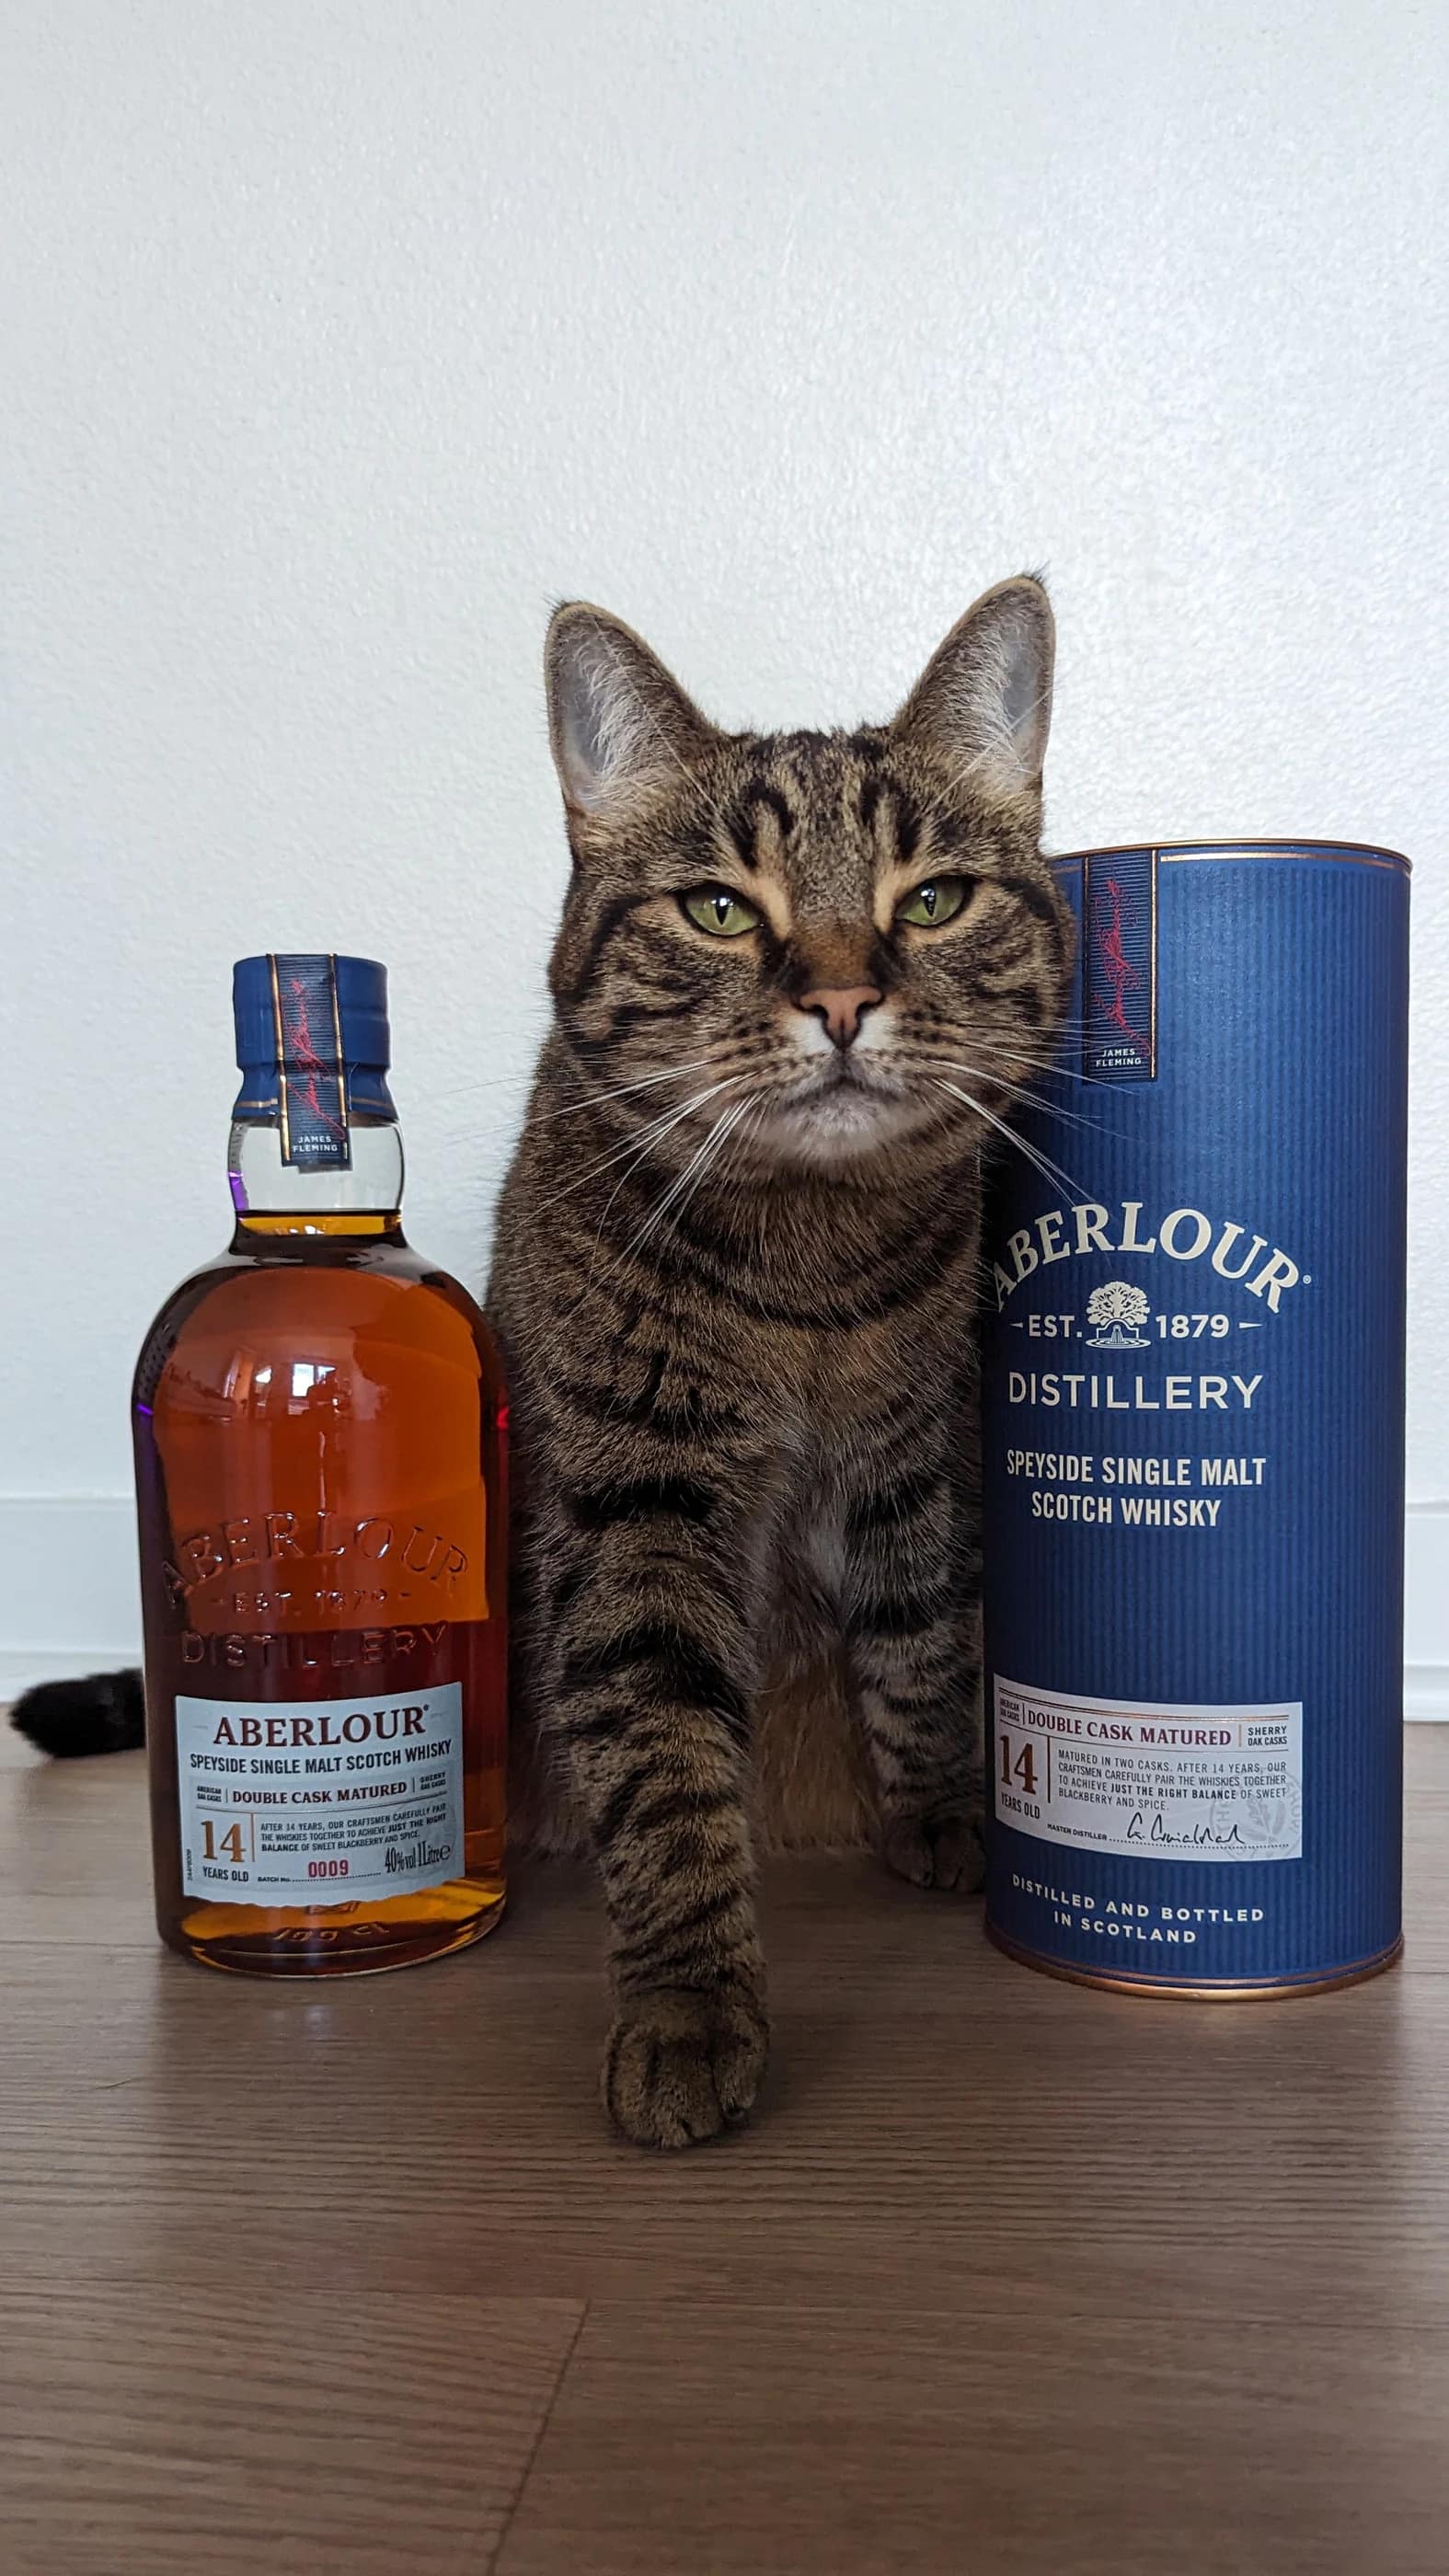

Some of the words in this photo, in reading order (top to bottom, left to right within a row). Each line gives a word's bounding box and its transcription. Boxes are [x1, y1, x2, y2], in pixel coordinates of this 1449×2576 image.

[1096, 1056, 1143, 1067] FLEMING
[1102, 1047, 1136, 1058] JAMES
[293, 1144, 339, 1153] FLEMING
[297, 1135, 332, 1144] JAMES
[1029, 1315, 1083, 1338] EST.
[1156, 1315, 1230, 1339] 1879
[1008, 1372, 1264, 1409] DISTILLERY
[1006, 1449, 1094, 1483] SPEYSIDE
[1102, 1457, 1191, 1487] SINGLE
[1201, 1457, 1267, 1487] MALT
[1031, 1491, 1112, 1524] SCOTCH
[1120, 1497, 1222, 1527] WHISKY
[162, 1512, 467, 1609] ABERLOUR
[182, 1620, 449, 1668] DISTILLERY
[1028, 1709, 1082, 1735] DOUBLE
[1087, 1721, 1133, 1742] CASK
[1140, 1727, 1232, 1746] MATURED
[1248, 1725, 1288, 1736] SHERRY
[1248, 1737, 1262, 1746] OAK
[1264, 1736, 1288, 1746] CASKS
[190, 1754, 247, 1774] SPEYSIDE
[250, 1758, 301, 1774] SINGLE
[305, 1757, 343, 1774] MALT
[346, 1749, 401, 1771] SCOTCH
[405, 1739, 453, 1763] WHISKY
[1000, 1734, 1039, 1795] 14
[1058, 1749, 1098, 1765] MATURED
[1101, 1755, 1110, 1766] IN
[1115, 1757, 1133, 1769] TWO
[1137, 1760, 1173, 1772] CASKS.
[1177, 1763, 1208, 1774] AFTER
[1213, 1764, 1224, 1774] 14
[1228, 1763, 1264, 1775] YEARS,
[1267, 1761, 1286, 1772] OUR
[1058, 1763, 1102, 1778] CRAFTSMEN
[1104, 1769, 1152, 1784] CAREFULLY
[1155, 1775, 1175, 1785] PAIR
[1179, 1776, 1195, 1786] THE
[1199, 1776, 1240, 1787] WHISKIES
[1244, 1775, 1287, 1786] TOGETHER
[1058, 1775, 1068, 1786] TO
[1071, 1777, 1108, 1792] ACHIEVE
[1110, 1783, 1133, 1795] JUST
[1136, 1786, 1154, 1797] THE
[1157, 1788, 1189, 1799] RIGHT
[1191, 1789, 1237, 1800] BALANCE
[1241, 1789, 1253, 1799] OF
[1256, 1788, 1287, 1799] SWEET
[233, 1790, 288, 1803] DOUBLE
[292, 1790, 332, 1803] CASK
[338, 1781, 408, 1801] MATURED
[1058, 1788, 1112, 1805] BLACKBERRY
[1115, 1797, 1134, 1808] AND
[1137, 1800, 1169, 1811] SPICE.
[1001, 1791, 1022, 1813] YEARS
[1024, 1800, 1041, 1820] OLD
[260, 1823, 282, 1832] AFTER
[286, 1823, 295, 1831] 14
[298, 1822, 326, 1832] YEARS,
[328, 1821, 344, 1830] OUR
[347, 1815, 391, 1828] CRAFTSMEN
[393, 1806, 430, 1821] CAREFULLY
[261, 1833, 274, 1841] THE
[275, 1833, 307, 1841] WHISKIES
[309, 1830, 345, 1841] TOGETHER
[347, 1829, 356, 1838] TO
[357, 1826, 386, 1837] ACHIEVE
[387, 1823, 407, 1833] JUST
[409, 1818, 423, 1828] THE
[426, 1813, 446, 1825] RIGHT
[201, 1821, 247, 1863] 14
[261, 1843, 299, 1852] BALANCE
[301, 1843, 310, 1851] OF
[312, 1841, 336, 1851] SWEET
[338, 1836, 384, 1848] BLACKBERRY
[385, 1834, 398, 1844] AND
[1047, 1823, 1072, 1835] MASTER
[1073, 1828, 1108, 1841] DISTILLER
[202, 1866, 229, 1880] YEARS
[232, 1870, 249, 1882] OLD
[307, 1859, 349, 1879] 0009
[1012, 1873, 1095, 1909] DISTILLED
[1105, 1901, 1150, 1918] AND
[1161, 1906, 1264, 1923] BOTTLED
[1054, 1911, 1072, 1927] IN
[1081, 1917, 1196, 1944] SCOTLAND
